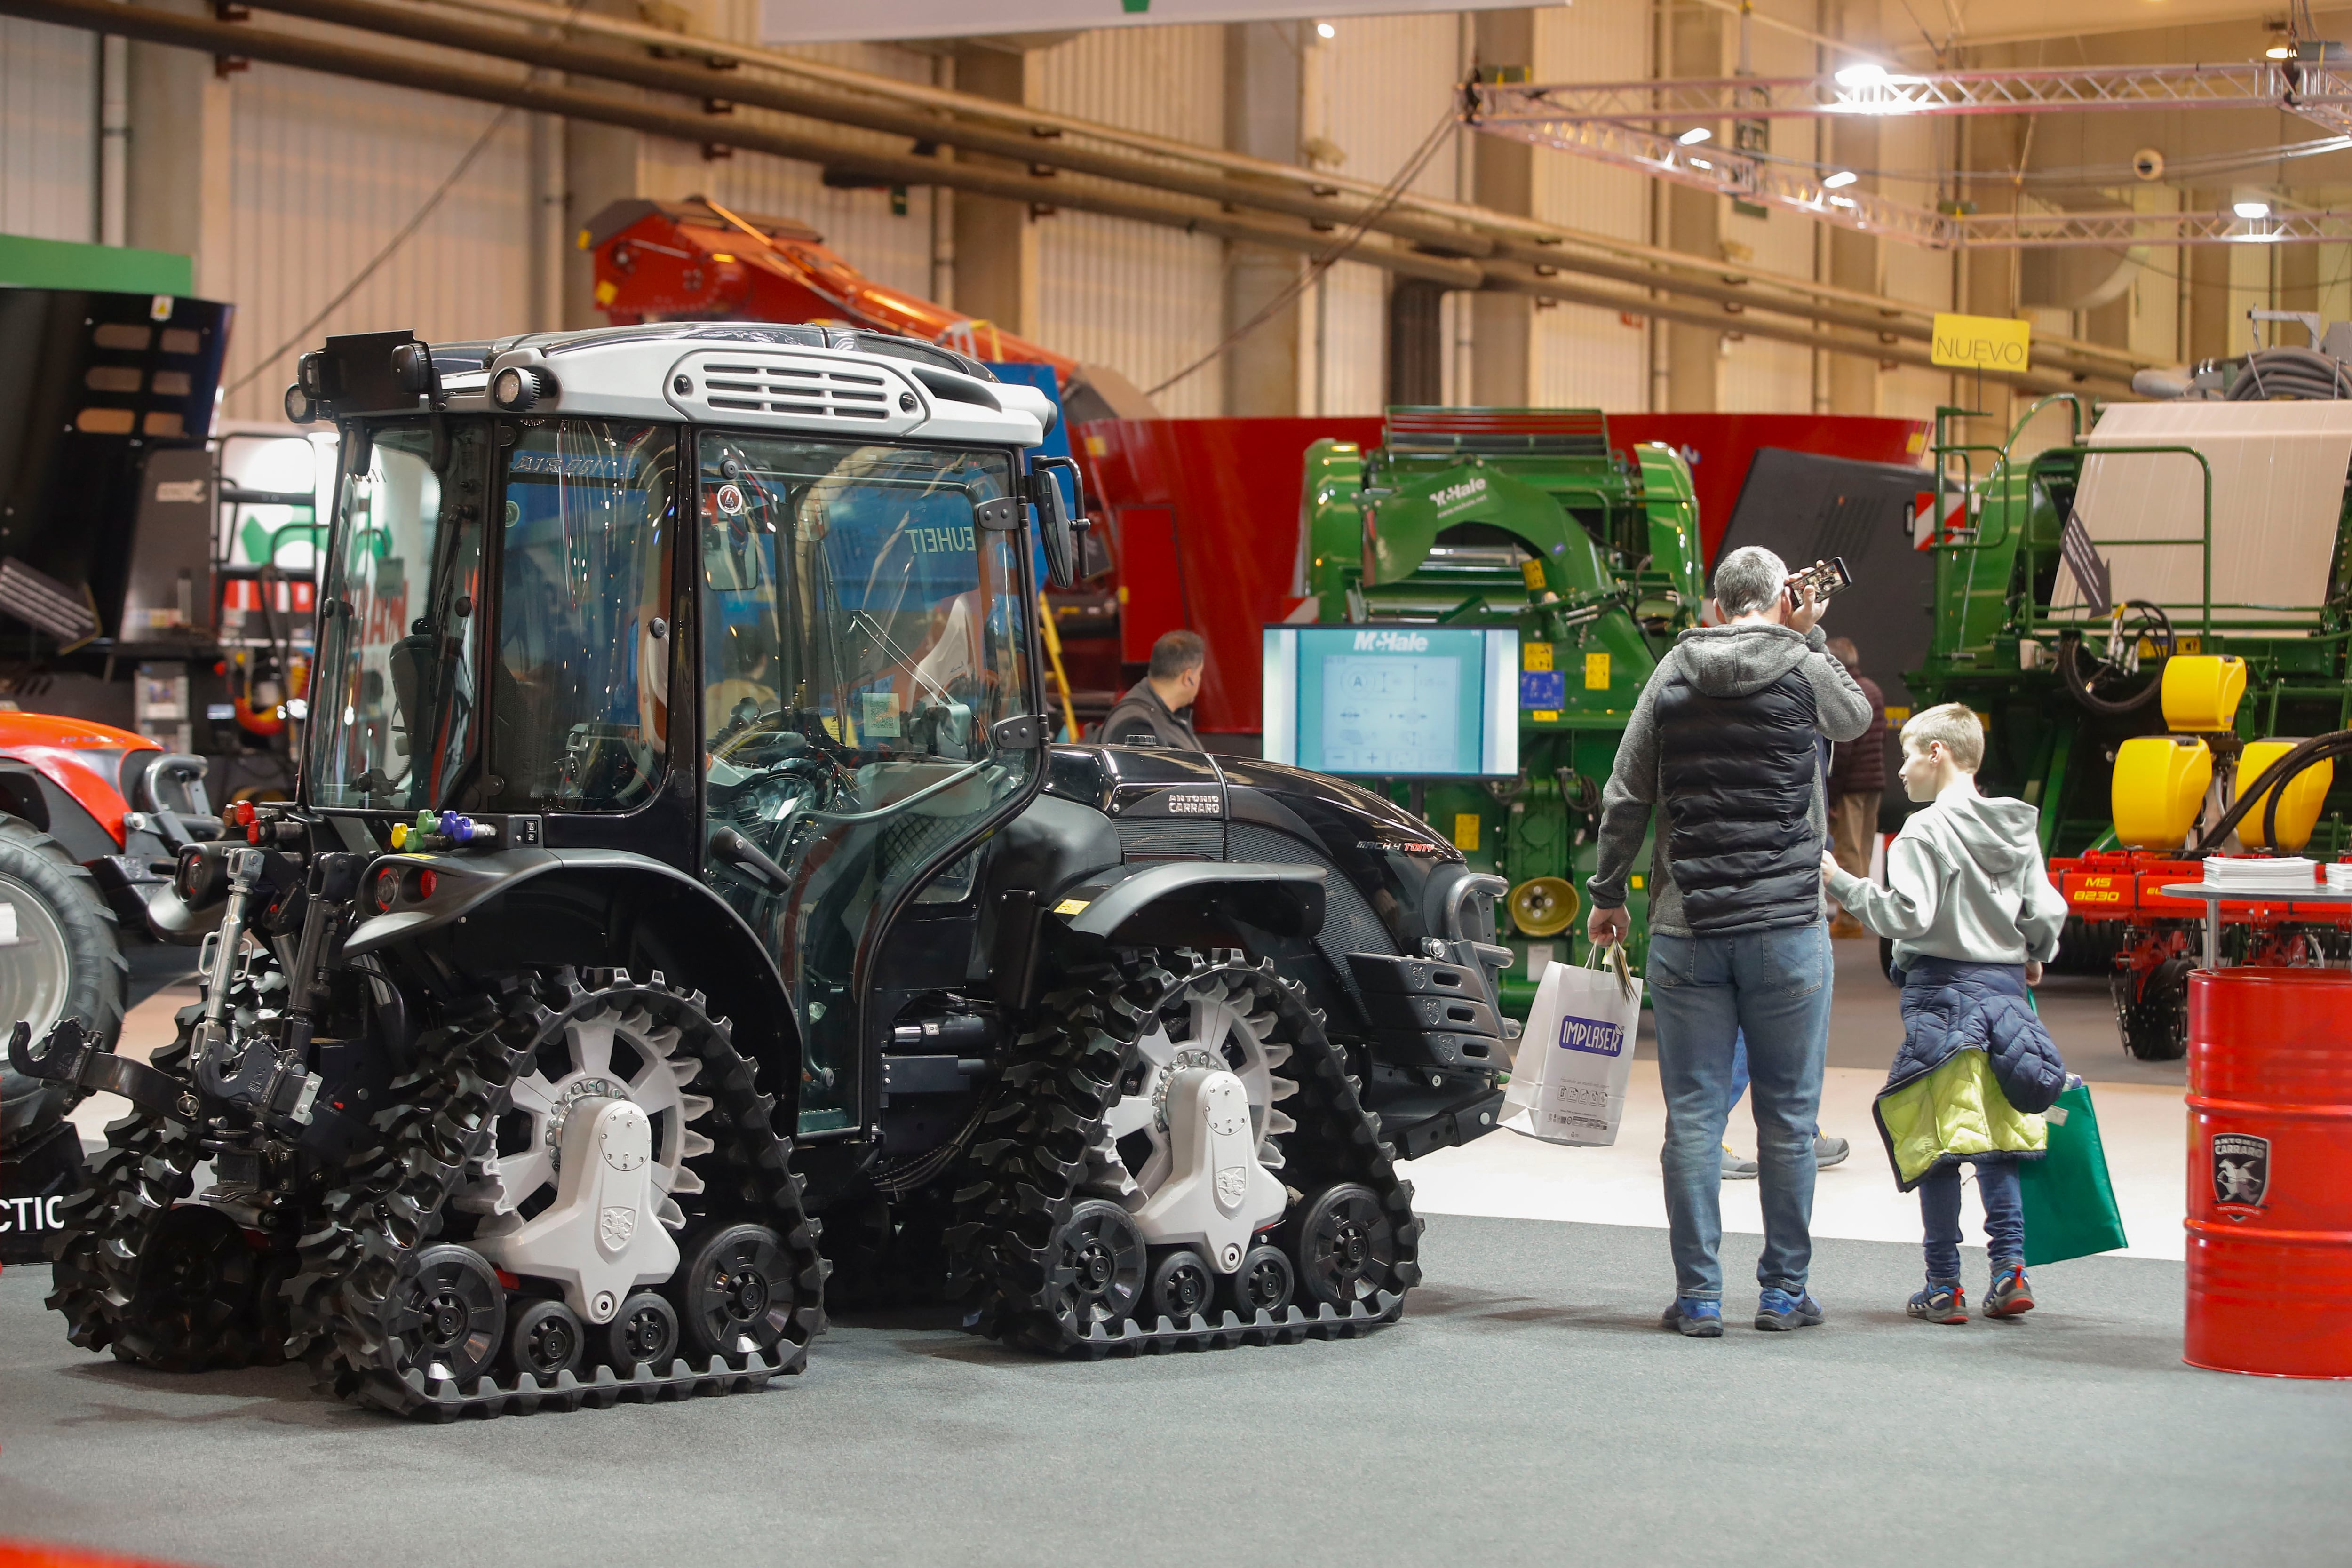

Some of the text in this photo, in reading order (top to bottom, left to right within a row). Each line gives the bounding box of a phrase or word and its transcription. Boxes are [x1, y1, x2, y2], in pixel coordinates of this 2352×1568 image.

[1937, 337, 2023, 364] NUEVO
[1168, 803, 1219, 814] CARRARO
[1356, 840, 1391, 850] MACH
[1404, 842, 1435, 852] TONY
[2085, 877, 2112, 888] MS
[2073, 891, 2120, 902] 8230
[1562, 1021, 1620, 1052] IMPLASER
[2215, 1138, 2265, 1149] ANTONIO
[2215, 1145, 2264, 1159] CARRARO
